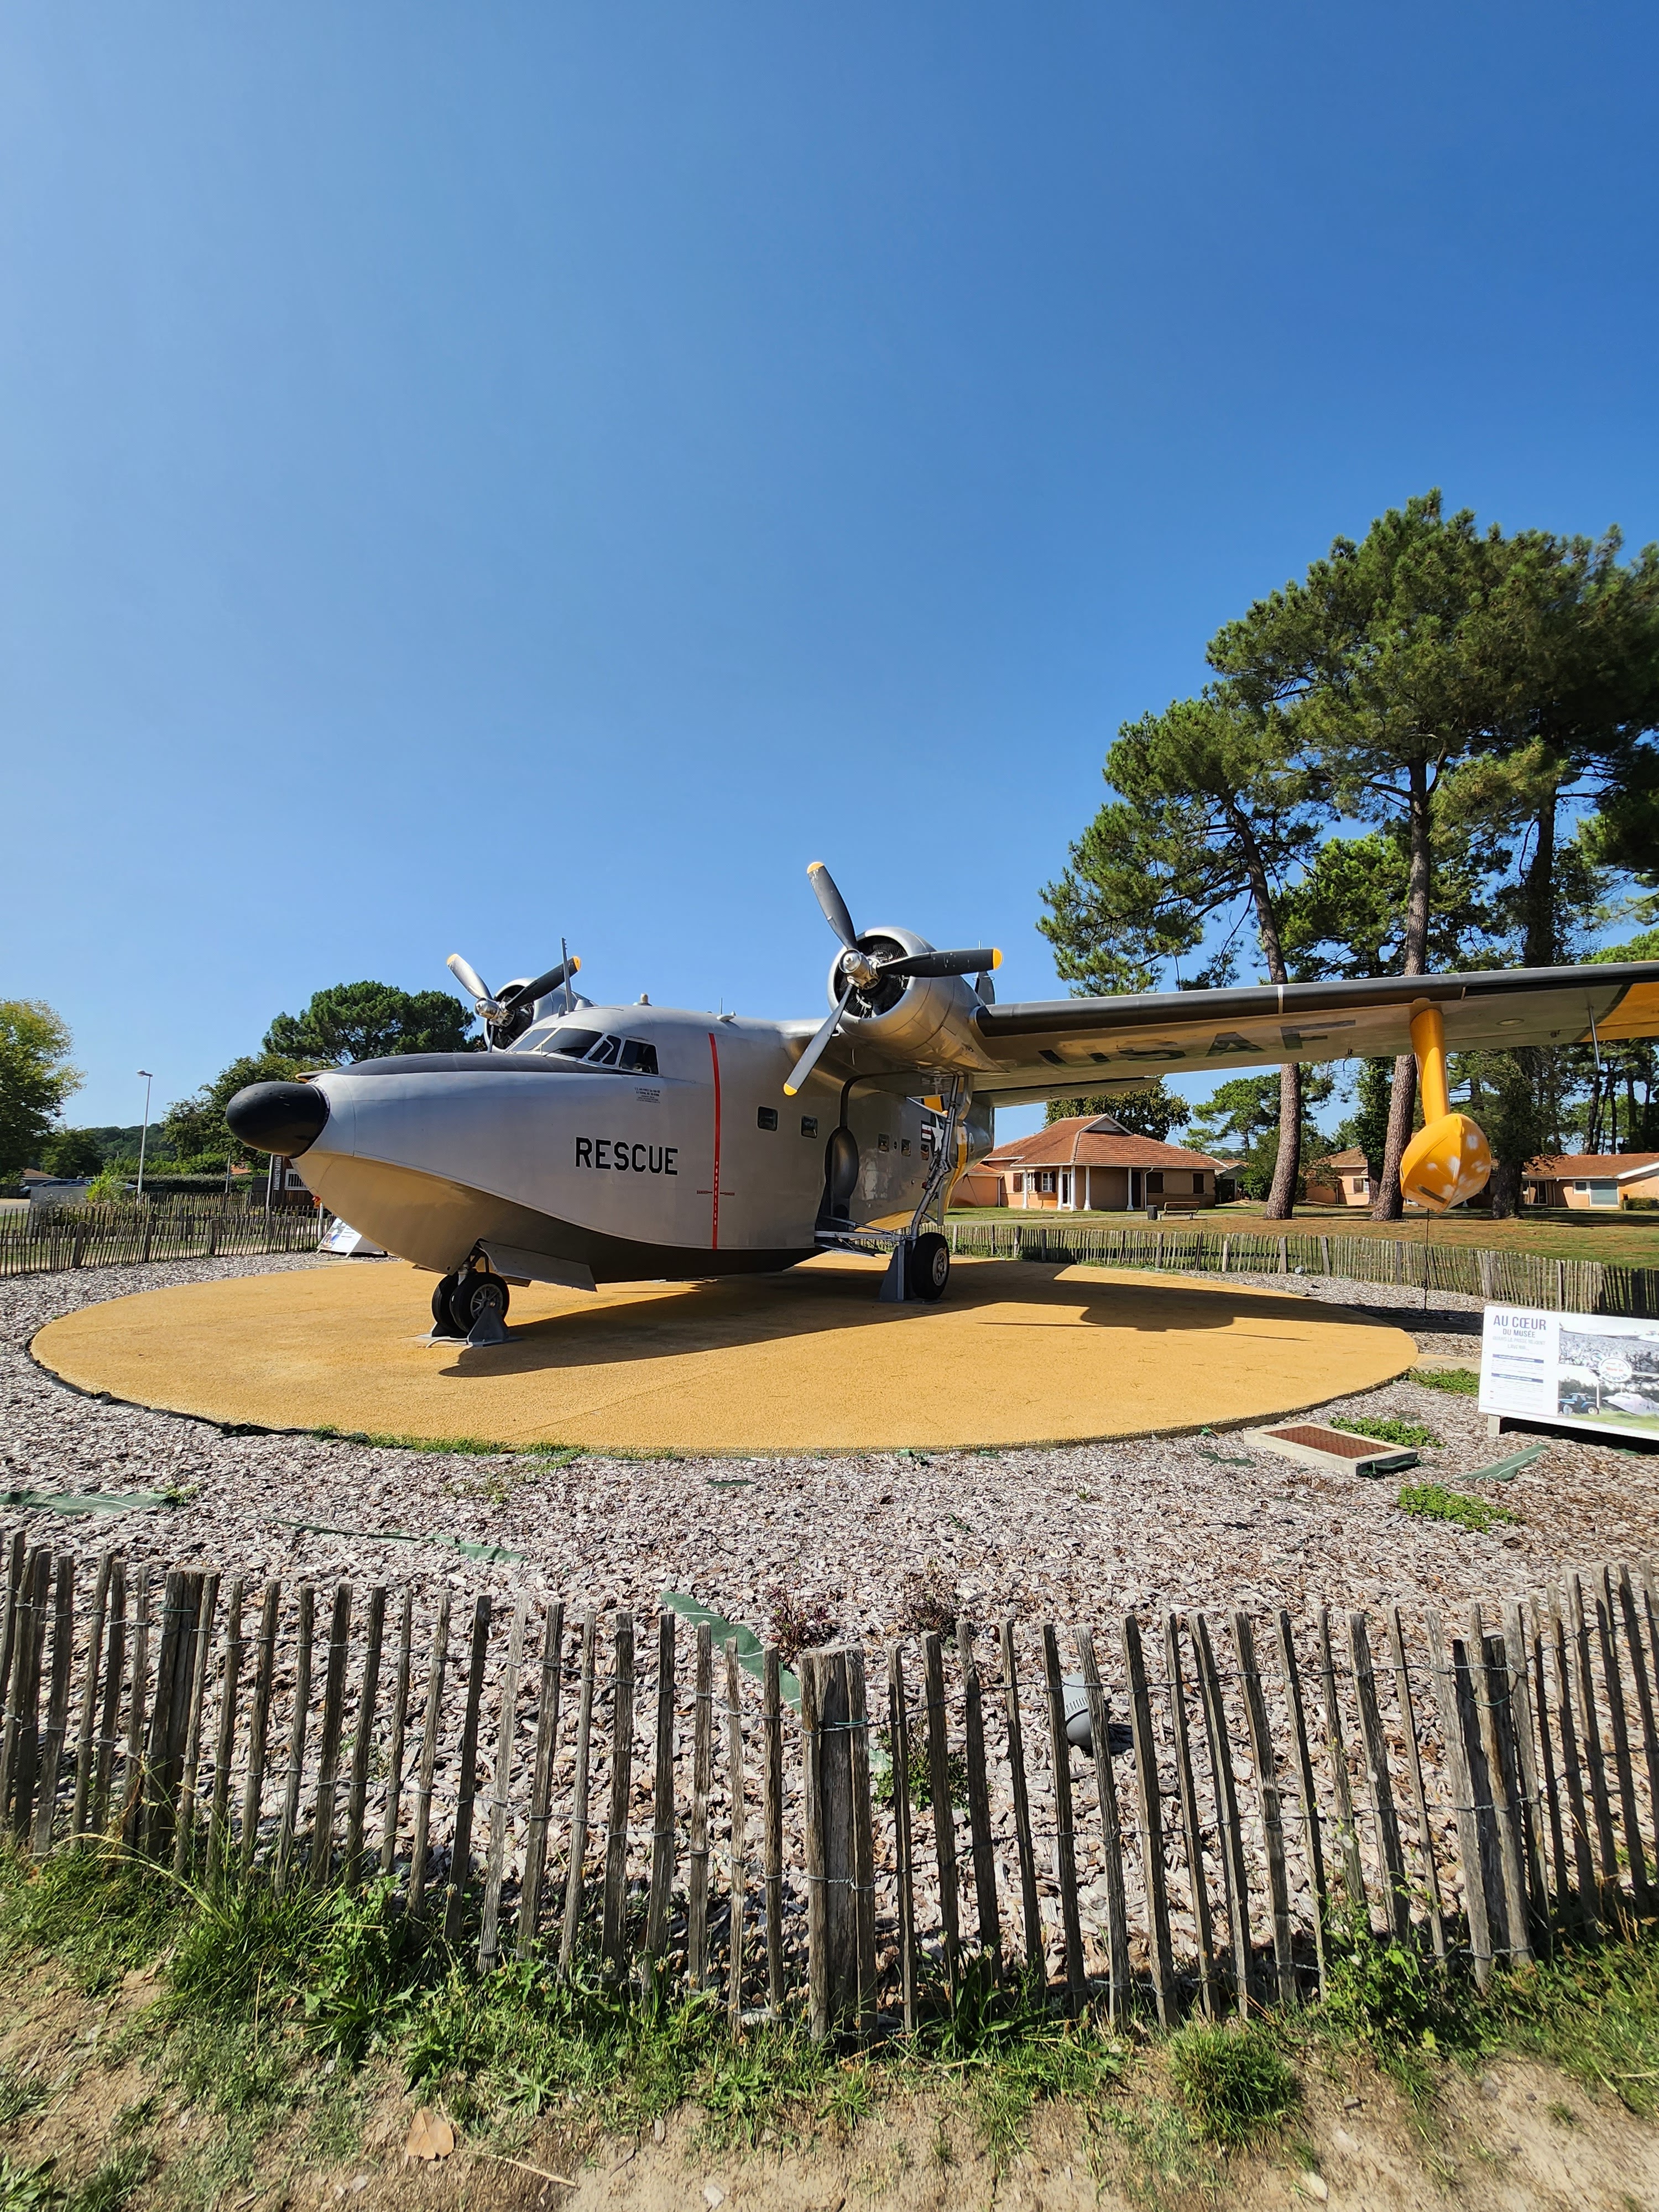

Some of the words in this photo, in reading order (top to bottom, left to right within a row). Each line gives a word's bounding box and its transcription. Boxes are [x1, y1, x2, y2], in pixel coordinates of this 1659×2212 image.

[576, 1136, 678, 1176] RESCUE
[273, 1156, 282, 1191] ADMINISTRATION
[1493, 1315, 1508, 1327] AU
[1512, 1317, 1546, 1331] CŒUR
[1514, 1329, 1536, 1338] MUSÉE
